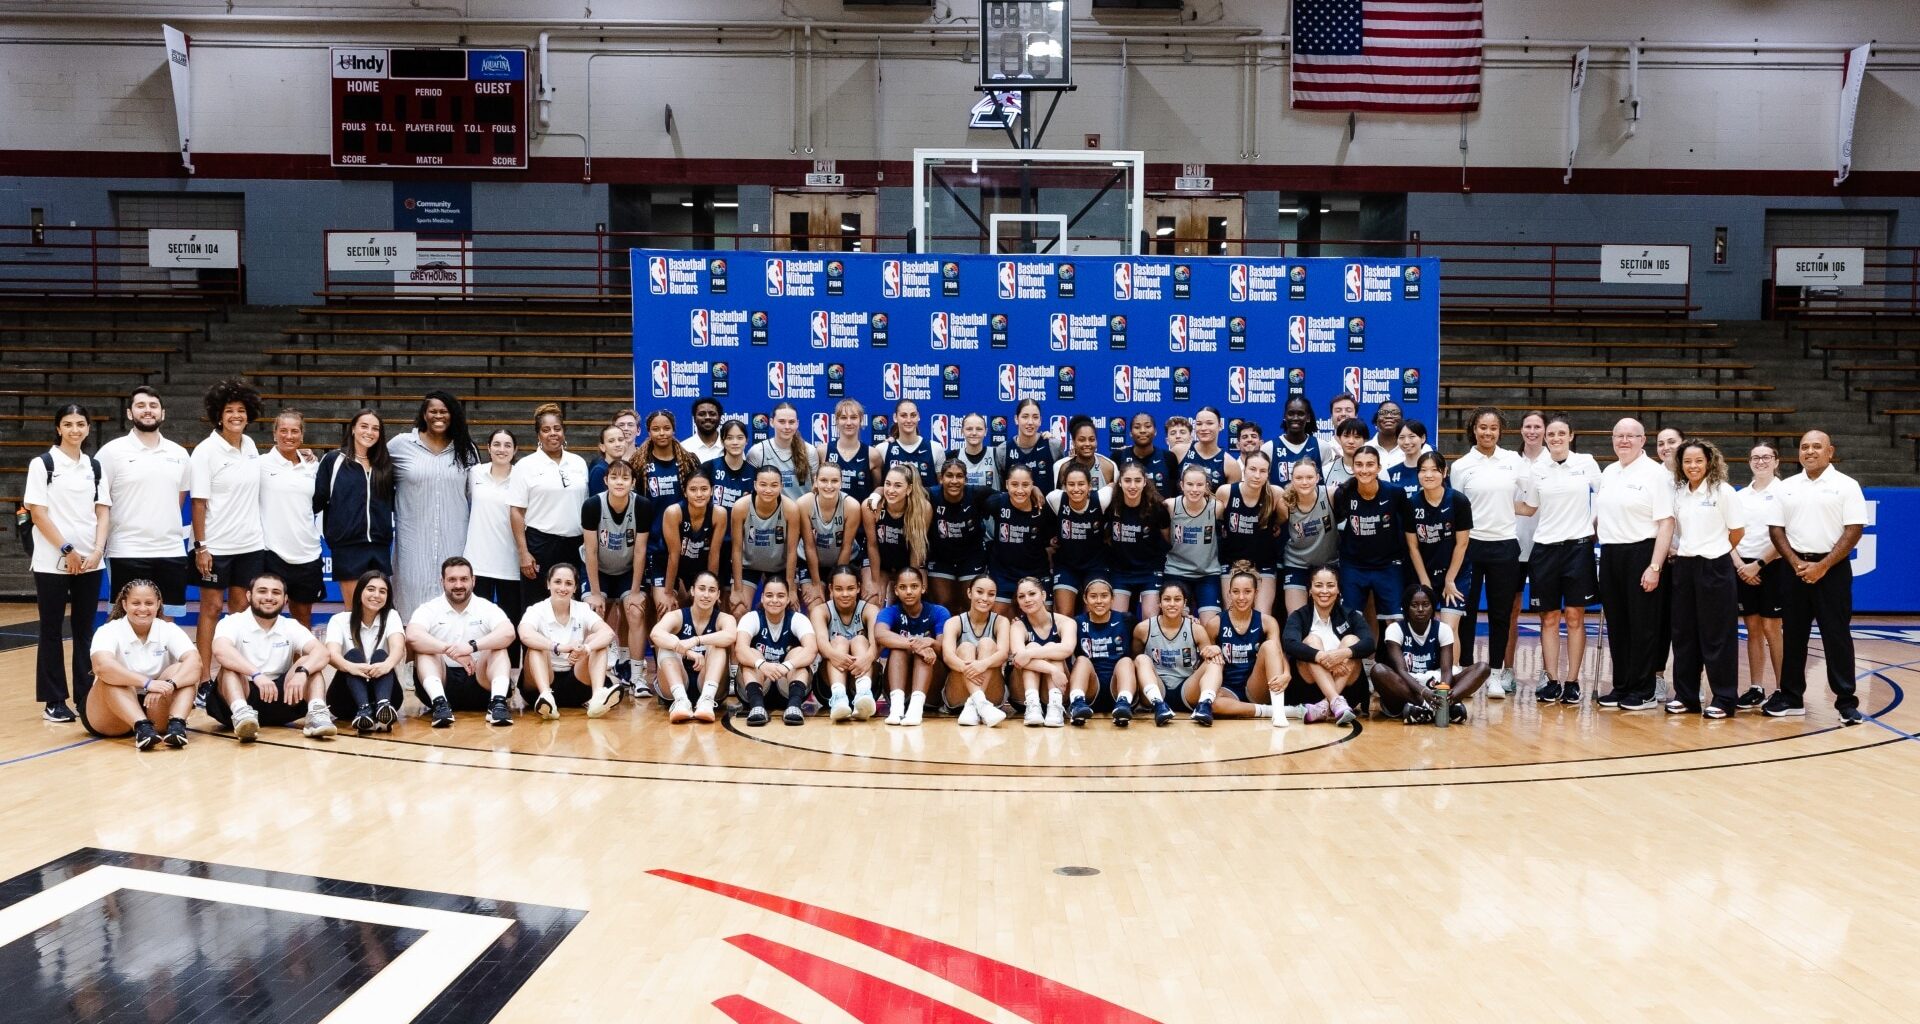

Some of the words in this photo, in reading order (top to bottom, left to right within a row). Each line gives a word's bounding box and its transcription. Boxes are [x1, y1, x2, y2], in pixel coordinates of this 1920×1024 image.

[481, 59, 511, 71] AQUAFINA
[347, 81, 380, 93] HOME
[415, 88, 442, 97] PERIOD
[475, 82, 511, 94] GUEST
[342, 123, 366, 132] FOULS
[375, 123, 396, 132] T.O.L.
[405, 123, 434, 132] PLAYER
[435, 124, 455, 132] FOUL
[464, 124, 484, 133] T.O.L.
[492, 125, 516, 133] FOULS
[342, 155, 366, 164] SCORE
[416, 156, 442, 165] MATCH
[492, 157, 517, 165] SCORE
[416, 200, 451, 208] Community
[168, 244, 201, 254] SECTION
[205, 243, 219, 254] 104
[346, 246, 380, 257] SECTION
[384, 246, 397, 257] 105
[669, 258, 706, 271] Basketball
[786, 260, 823, 273] Basketball
[903, 261, 938, 274] Basketball
[1018, 263, 1054, 274] Basketball
[1134, 263, 1170, 276] Basketball
[1620, 259, 1653, 269] SECTION
[1656, 259, 1670, 270] 105
[1796, 261, 1829, 272] SECTION
[1832, 261, 1846, 272] 106
[410, 271, 457, 281] GREYHOUNDS
[669, 270, 696, 283] Without
[1249, 265, 1285, 278] Basketball
[1364, 265, 1400, 278] Basketball
[786, 272, 813, 285] Without
[902, 273, 929, 286] Without
[1018, 275, 1044, 288] Without
[1133, 275, 1160, 289] Without
[1249, 277, 1275, 290] Without
[1364, 277, 1390, 289] Without
[670, 282, 698, 294] Borders
[786, 284, 814, 296] Borders
[903, 285, 930, 297] Borders
[1018, 287, 1045, 298] Borders
[1134, 288, 1161, 299] Borders
[1249, 289, 1277, 301] Borders
[1364, 290, 1391, 301] Borders
[711, 310, 747, 323] Basketball
[831, 312, 867, 325] Basketball
[951, 313, 987, 326] Basketball
[1070, 315, 1106, 327] Basketball
[1189, 316, 1225, 327] Basketball
[1308, 317, 1344, 328] Basketball
[711, 322, 737, 335] Without
[831, 324, 857, 337] Without
[951, 325, 977, 338] Without
[1070, 326, 1096, 338] Without
[1189, 328, 1216, 341] Without
[711, 334, 738, 346] Borders
[1308, 329, 1334, 341] Without
[831, 336, 858, 348] Borders
[951, 337, 978, 349] Borders
[1070, 339, 1097, 350] Borders
[1189, 340, 1216, 351] Borders
[1308, 340, 1335, 352] Borders
[671, 361, 708, 374] Basketball
[787, 363, 823, 374] Basketball
[903, 364, 939, 375] Basketball
[1018, 365, 1054, 378] Basketball
[1133, 366, 1169, 379] Basketball
[1363, 368, 1399, 379] Basketball
[671, 373, 698, 386] Without
[1248, 368, 1284, 380] Basketball
[787, 375, 814, 386] Without
[903, 376, 929, 387] Without
[1018, 377, 1044, 390] Without
[1133, 378, 1159, 391] Without
[1248, 379, 1274, 392] Without
[1363, 380, 1389, 391] Without
[672, 385, 699, 397] Borders
[787, 387, 815, 398] Borders
[903, 388, 930, 400] Borders
[1133, 390, 1160, 401] Borders
[1248, 391, 1275, 402] Borders
[720, 412, 749, 425] sketball
[829, 452, 838, 463] 50
[1009, 449, 1019, 460] 46
[1277, 447, 1287, 457] 54
[984, 457, 993, 466] 32
[715, 469, 726, 480] 39
[1232, 497, 1240, 508] 18
[1350, 500, 1358, 510] 19
[936, 505, 946, 515] 47
[1000, 508, 1011, 519] 30
[1415, 508, 1425, 519] 23
[683, 624, 692, 635] 28
[1082, 621, 1090, 633] 31
[1223, 627, 1232, 638] 26
[1183, 632, 1188, 642] 9
